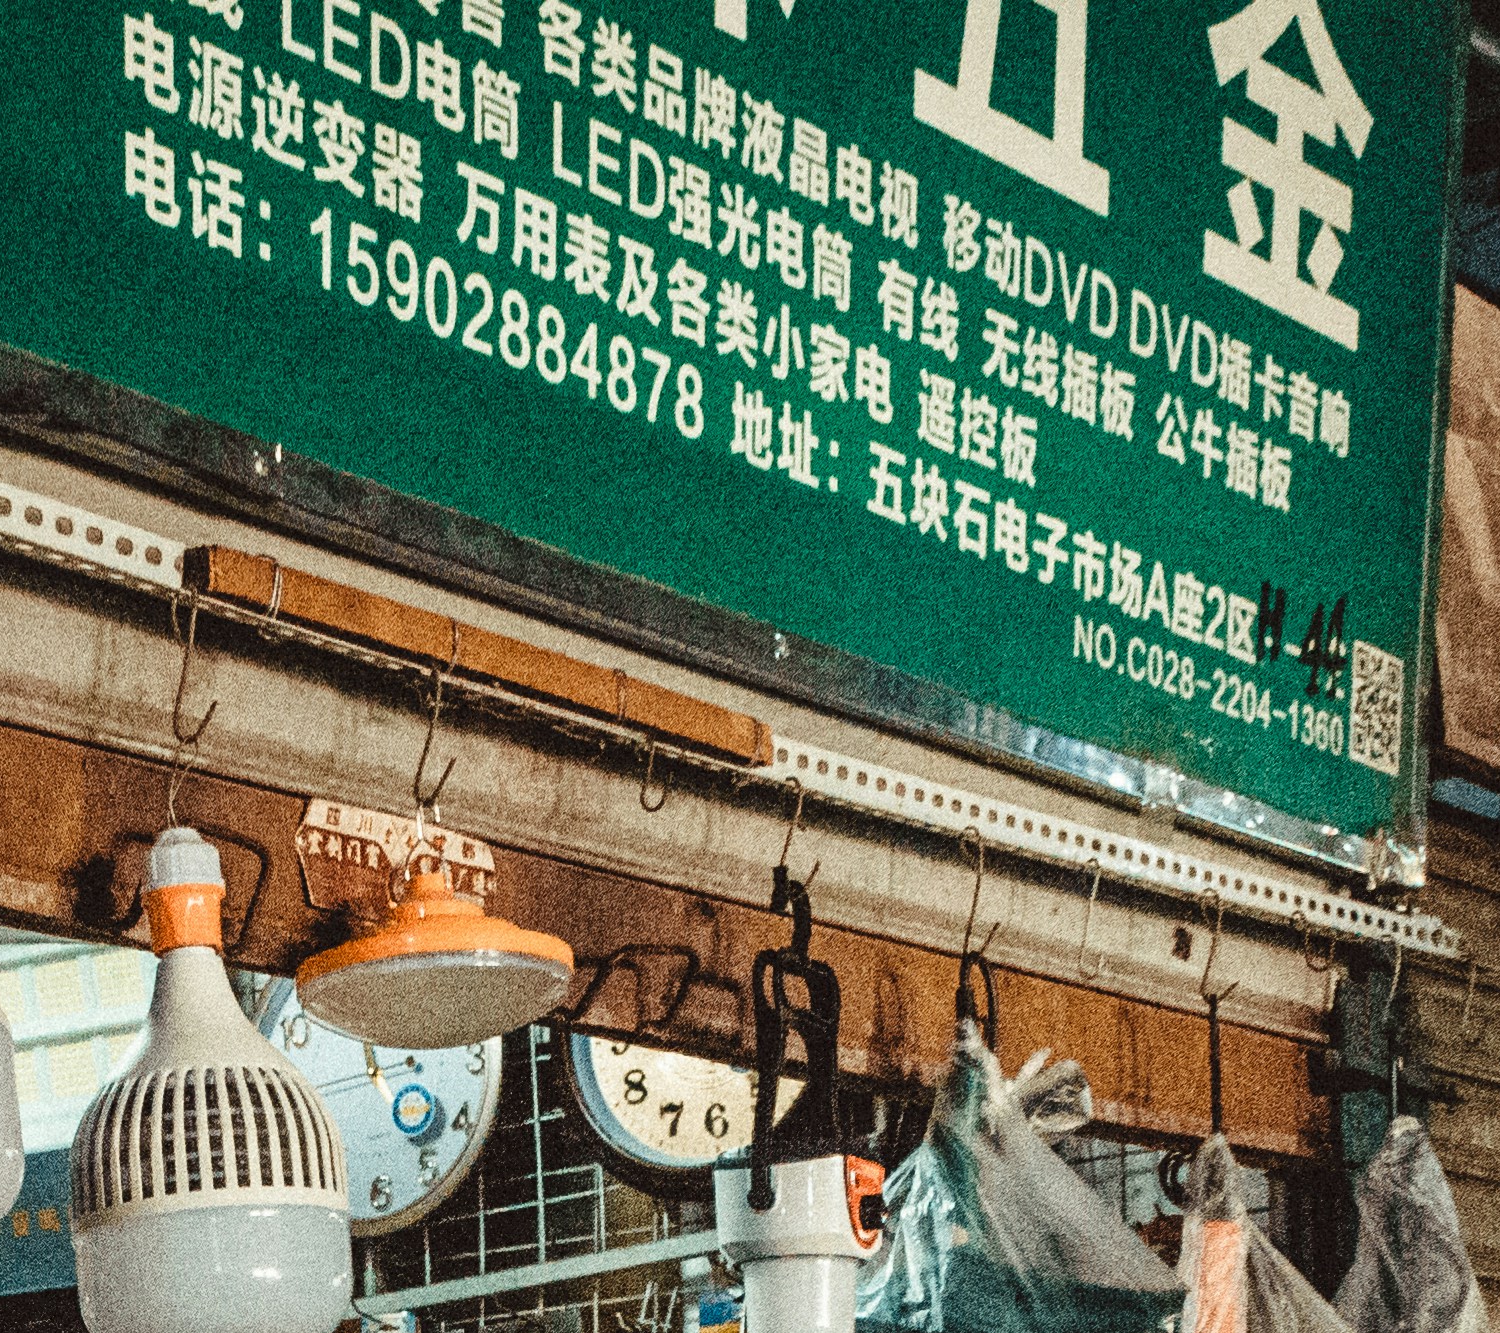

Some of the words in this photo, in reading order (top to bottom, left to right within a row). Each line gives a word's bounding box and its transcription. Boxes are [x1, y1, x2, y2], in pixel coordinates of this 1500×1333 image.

[538, 0, 919, 250] 各类品牌液晶电视
[943, 193, 1118, 340] 移动DVD
[1129, 288, 1351, 458] DVD插卡音响
[123, 13, 424, 224] 电源逆变器
[456, 161, 892, 426] 万用表及各类小家电
[917, 368, 1039, 488] 遥控板
[310, 206, 705, 440] 15902884878
[552, 101, 852, 313] LED强光电筒
[877, 259, 959, 362] 有线
[981, 309, 1136, 442] 无线插板
[1155, 394, 1292, 513] 公牛插板
[623, 1068, 649, 1105] 8
[450, 1100, 475, 1136] 4
[659, 1100, 684, 1138] 7
[703, 1103, 730, 1140] 6
[416, 1149, 442, 1188] 5
[369, 1173, 393, 1213] 6
